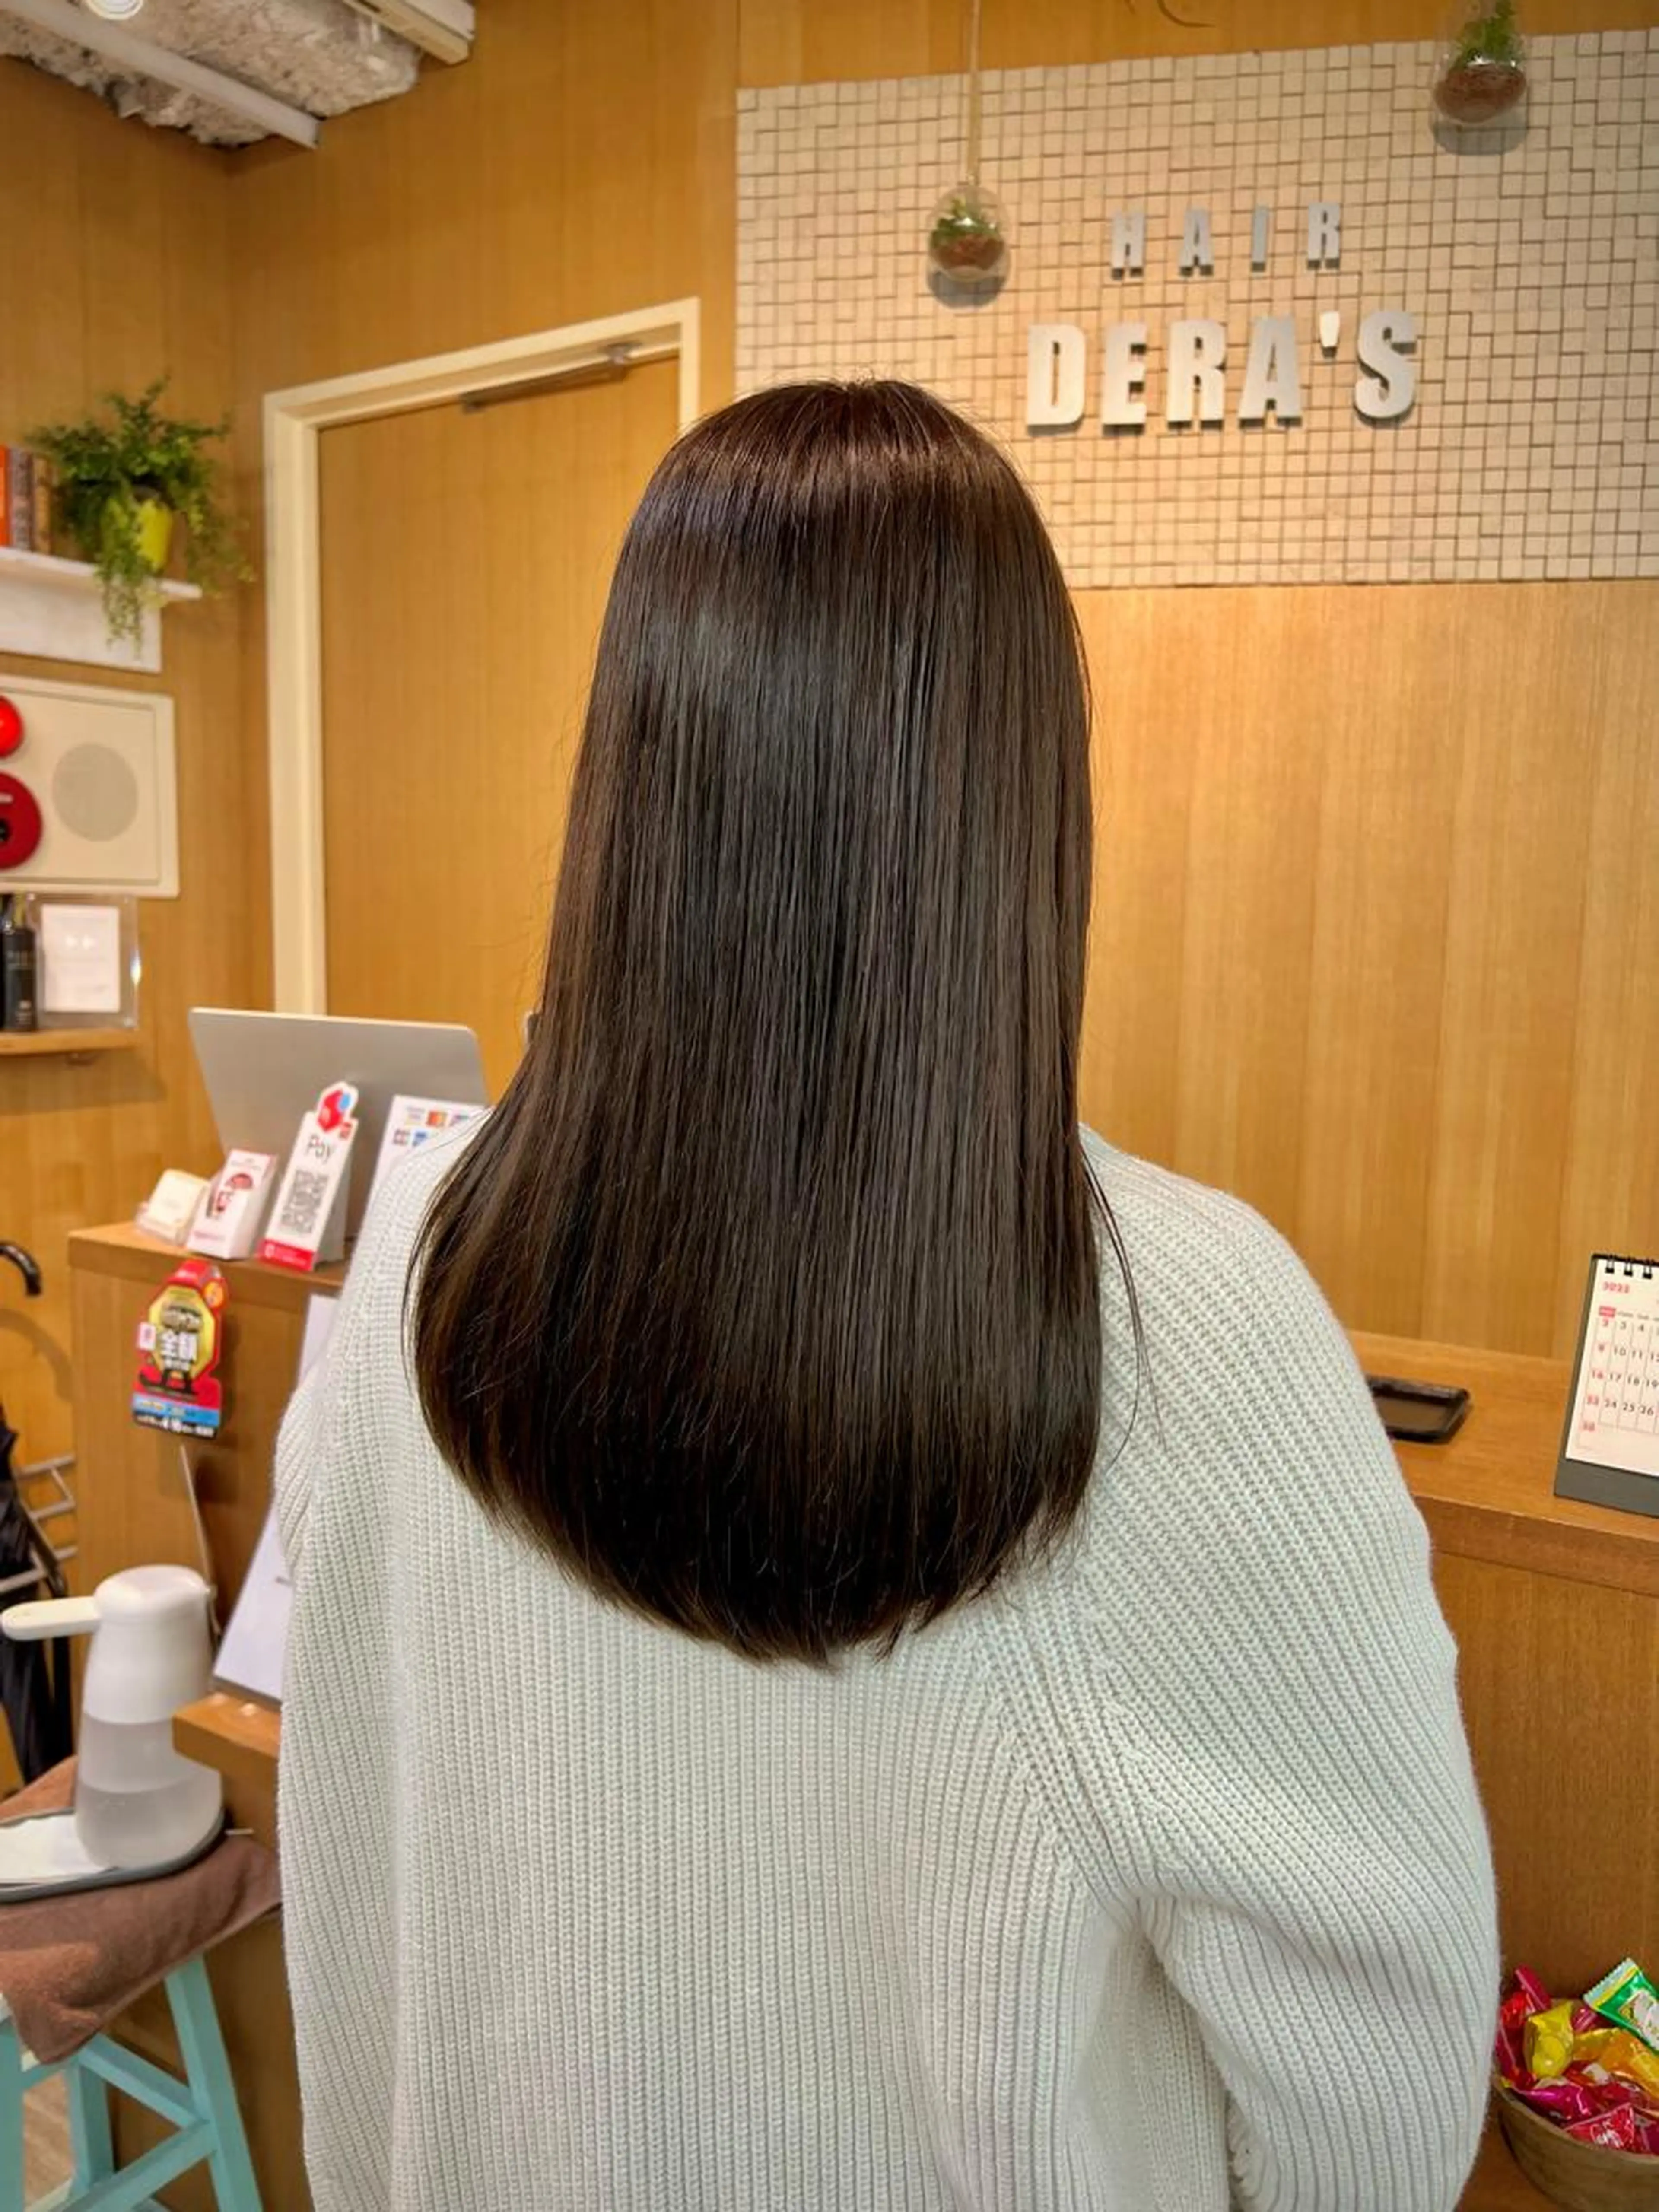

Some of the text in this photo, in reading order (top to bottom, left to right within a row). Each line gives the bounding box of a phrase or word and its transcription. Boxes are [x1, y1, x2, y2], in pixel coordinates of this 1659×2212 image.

[1111, 202, 1341, 277] HAIR
[1026, 310, 1418, 432] DERA'S
[1614, 1345, 1627, 1357] 10
[1632, 1349, 1643, 1360] 11
[1592, 1370, 1603, 1380] 16
[1610, 1373, 1622, 1382] 17
[1627, 1373, 1640, 1387] 18
[1604, 1398, 1617, 1409] 24
[1622, 1402, 1635, 1413] 25
[1638, 1405, 1654, 1416] 26
